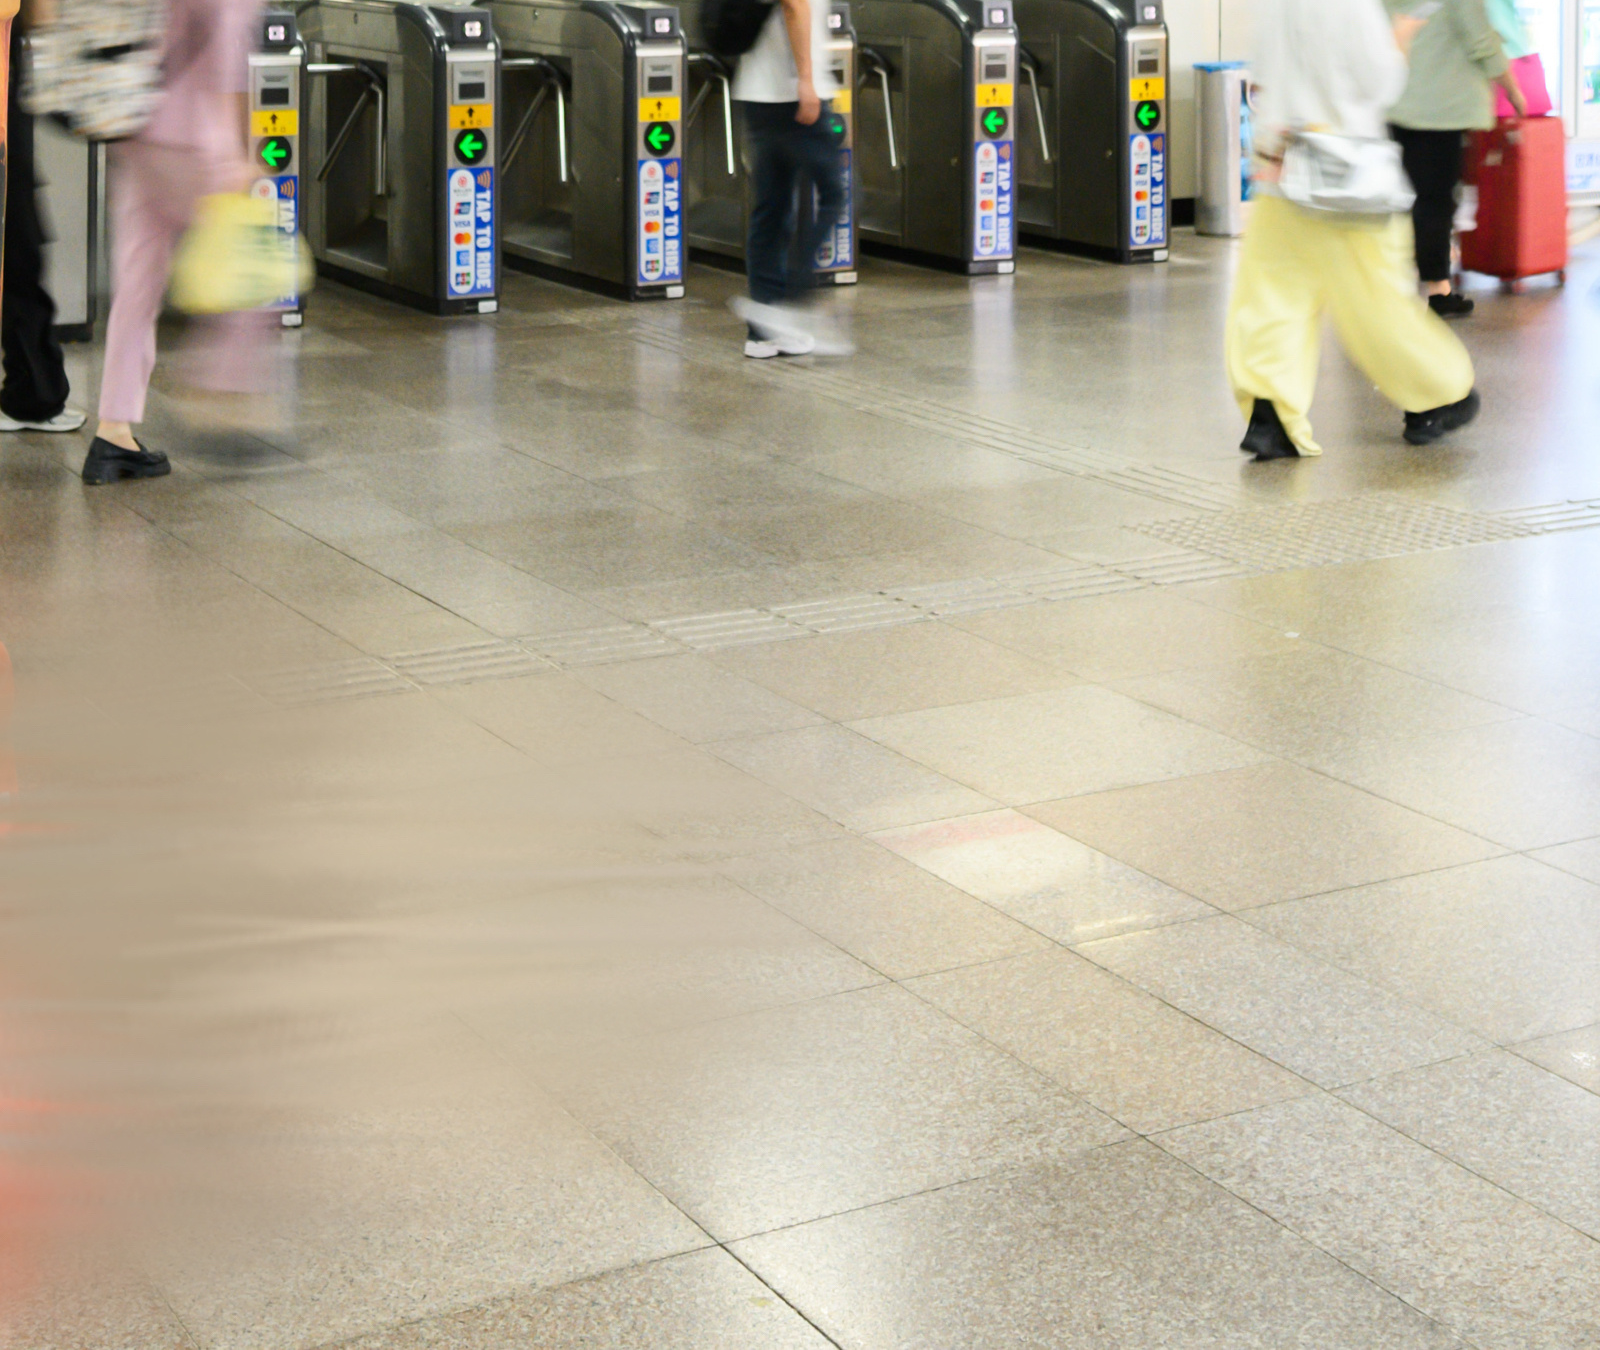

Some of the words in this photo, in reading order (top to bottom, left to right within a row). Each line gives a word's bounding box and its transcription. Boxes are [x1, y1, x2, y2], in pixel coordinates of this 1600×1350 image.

[997, 161, 1011, 191] TAP
[1150, 152, 1163, 182] TAP
[476, 190, 491, 223] TAP
[664, 180, 679, 212] TAP
[997, 194, 1011, 214] TO
[1150, 184, 1163, 205] TO
[278, 199, 296, 234] TAP
[664, 214, 679, 236] TO
[1150, 207, 1163, 241] RIDE
[476, 225, 491, 249] TO
[836, 227, 850, 263] RIDE
[997, 217, 1011, 251] RIDE
[476, 251, 491, 290] RIDE
[664, 239, 679, 276] RIDE
